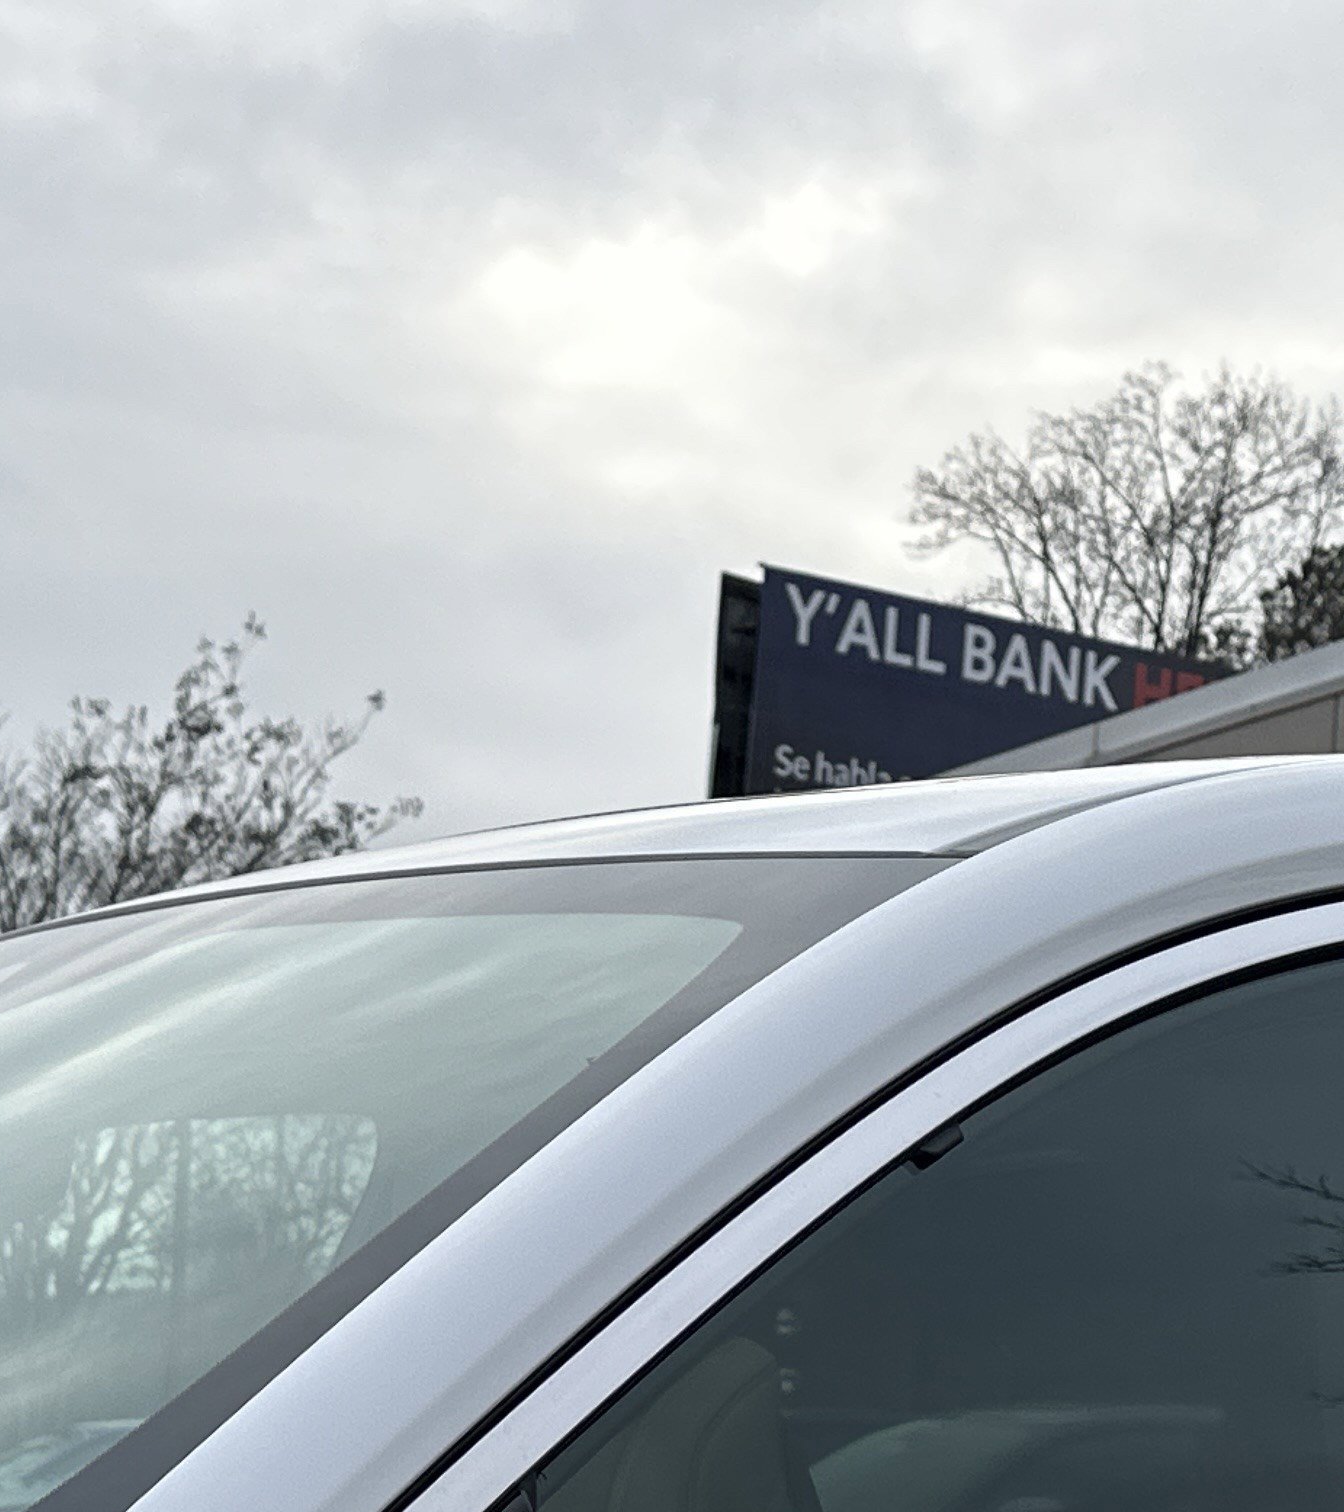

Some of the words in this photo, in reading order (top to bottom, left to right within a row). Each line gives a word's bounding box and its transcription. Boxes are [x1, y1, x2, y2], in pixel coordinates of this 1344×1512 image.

[784, 582, 948, 676] Y'ALL
[959, 621, 1122, 712] BANK
[773, 743, 811, 781] Se
